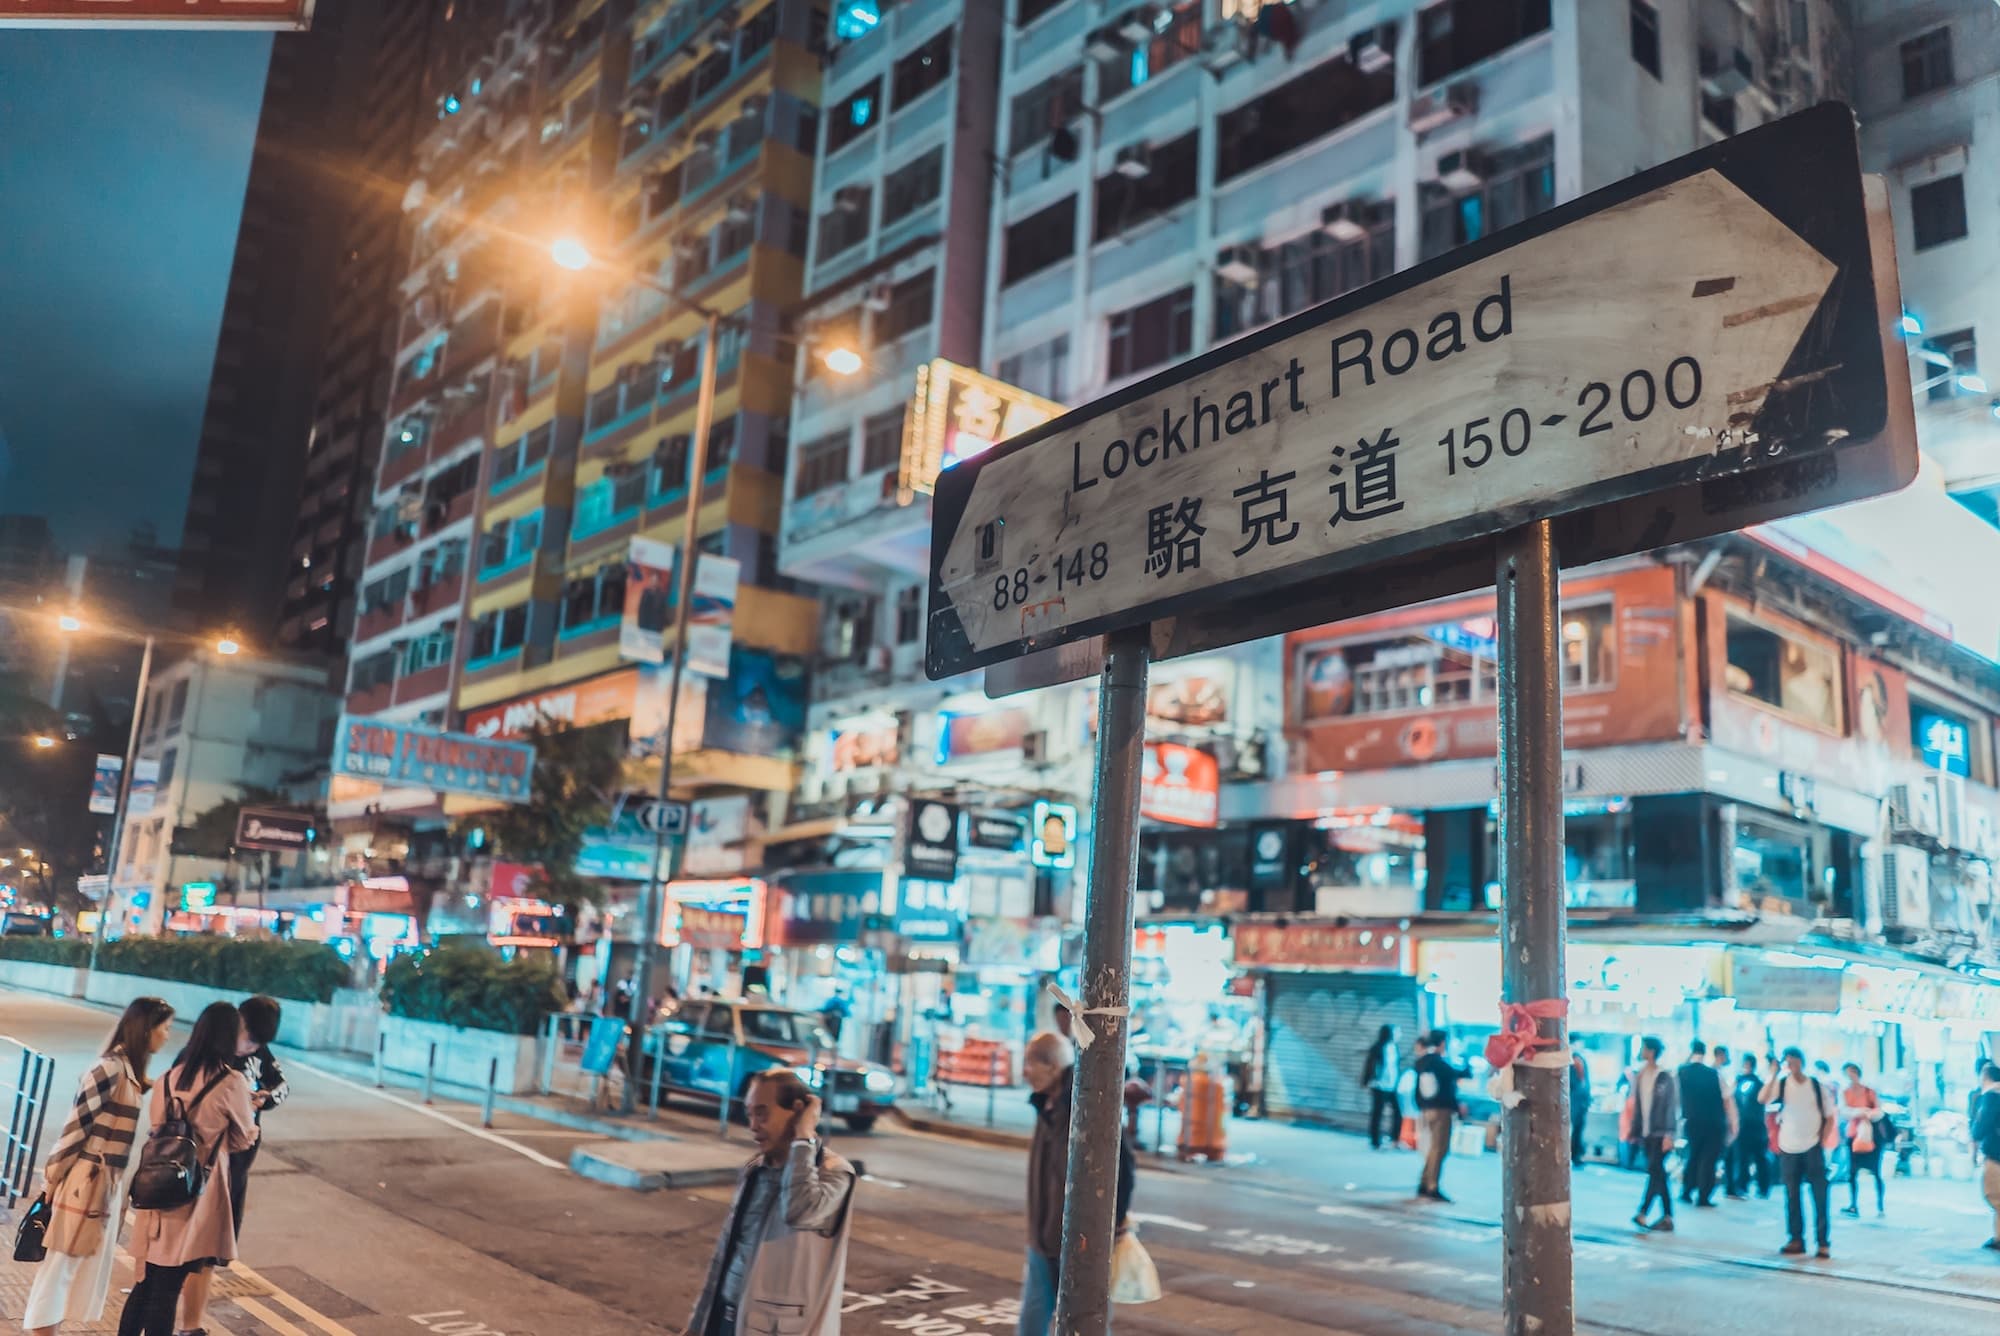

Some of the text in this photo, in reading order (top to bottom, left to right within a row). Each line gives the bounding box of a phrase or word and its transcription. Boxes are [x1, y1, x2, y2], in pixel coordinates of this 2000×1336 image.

[993, 356, 1702, 611] 88-148 駱克道 150-200
[1072, 358, 1305, 494] Lockhart
[1331, 274, 1513, 398] Road
